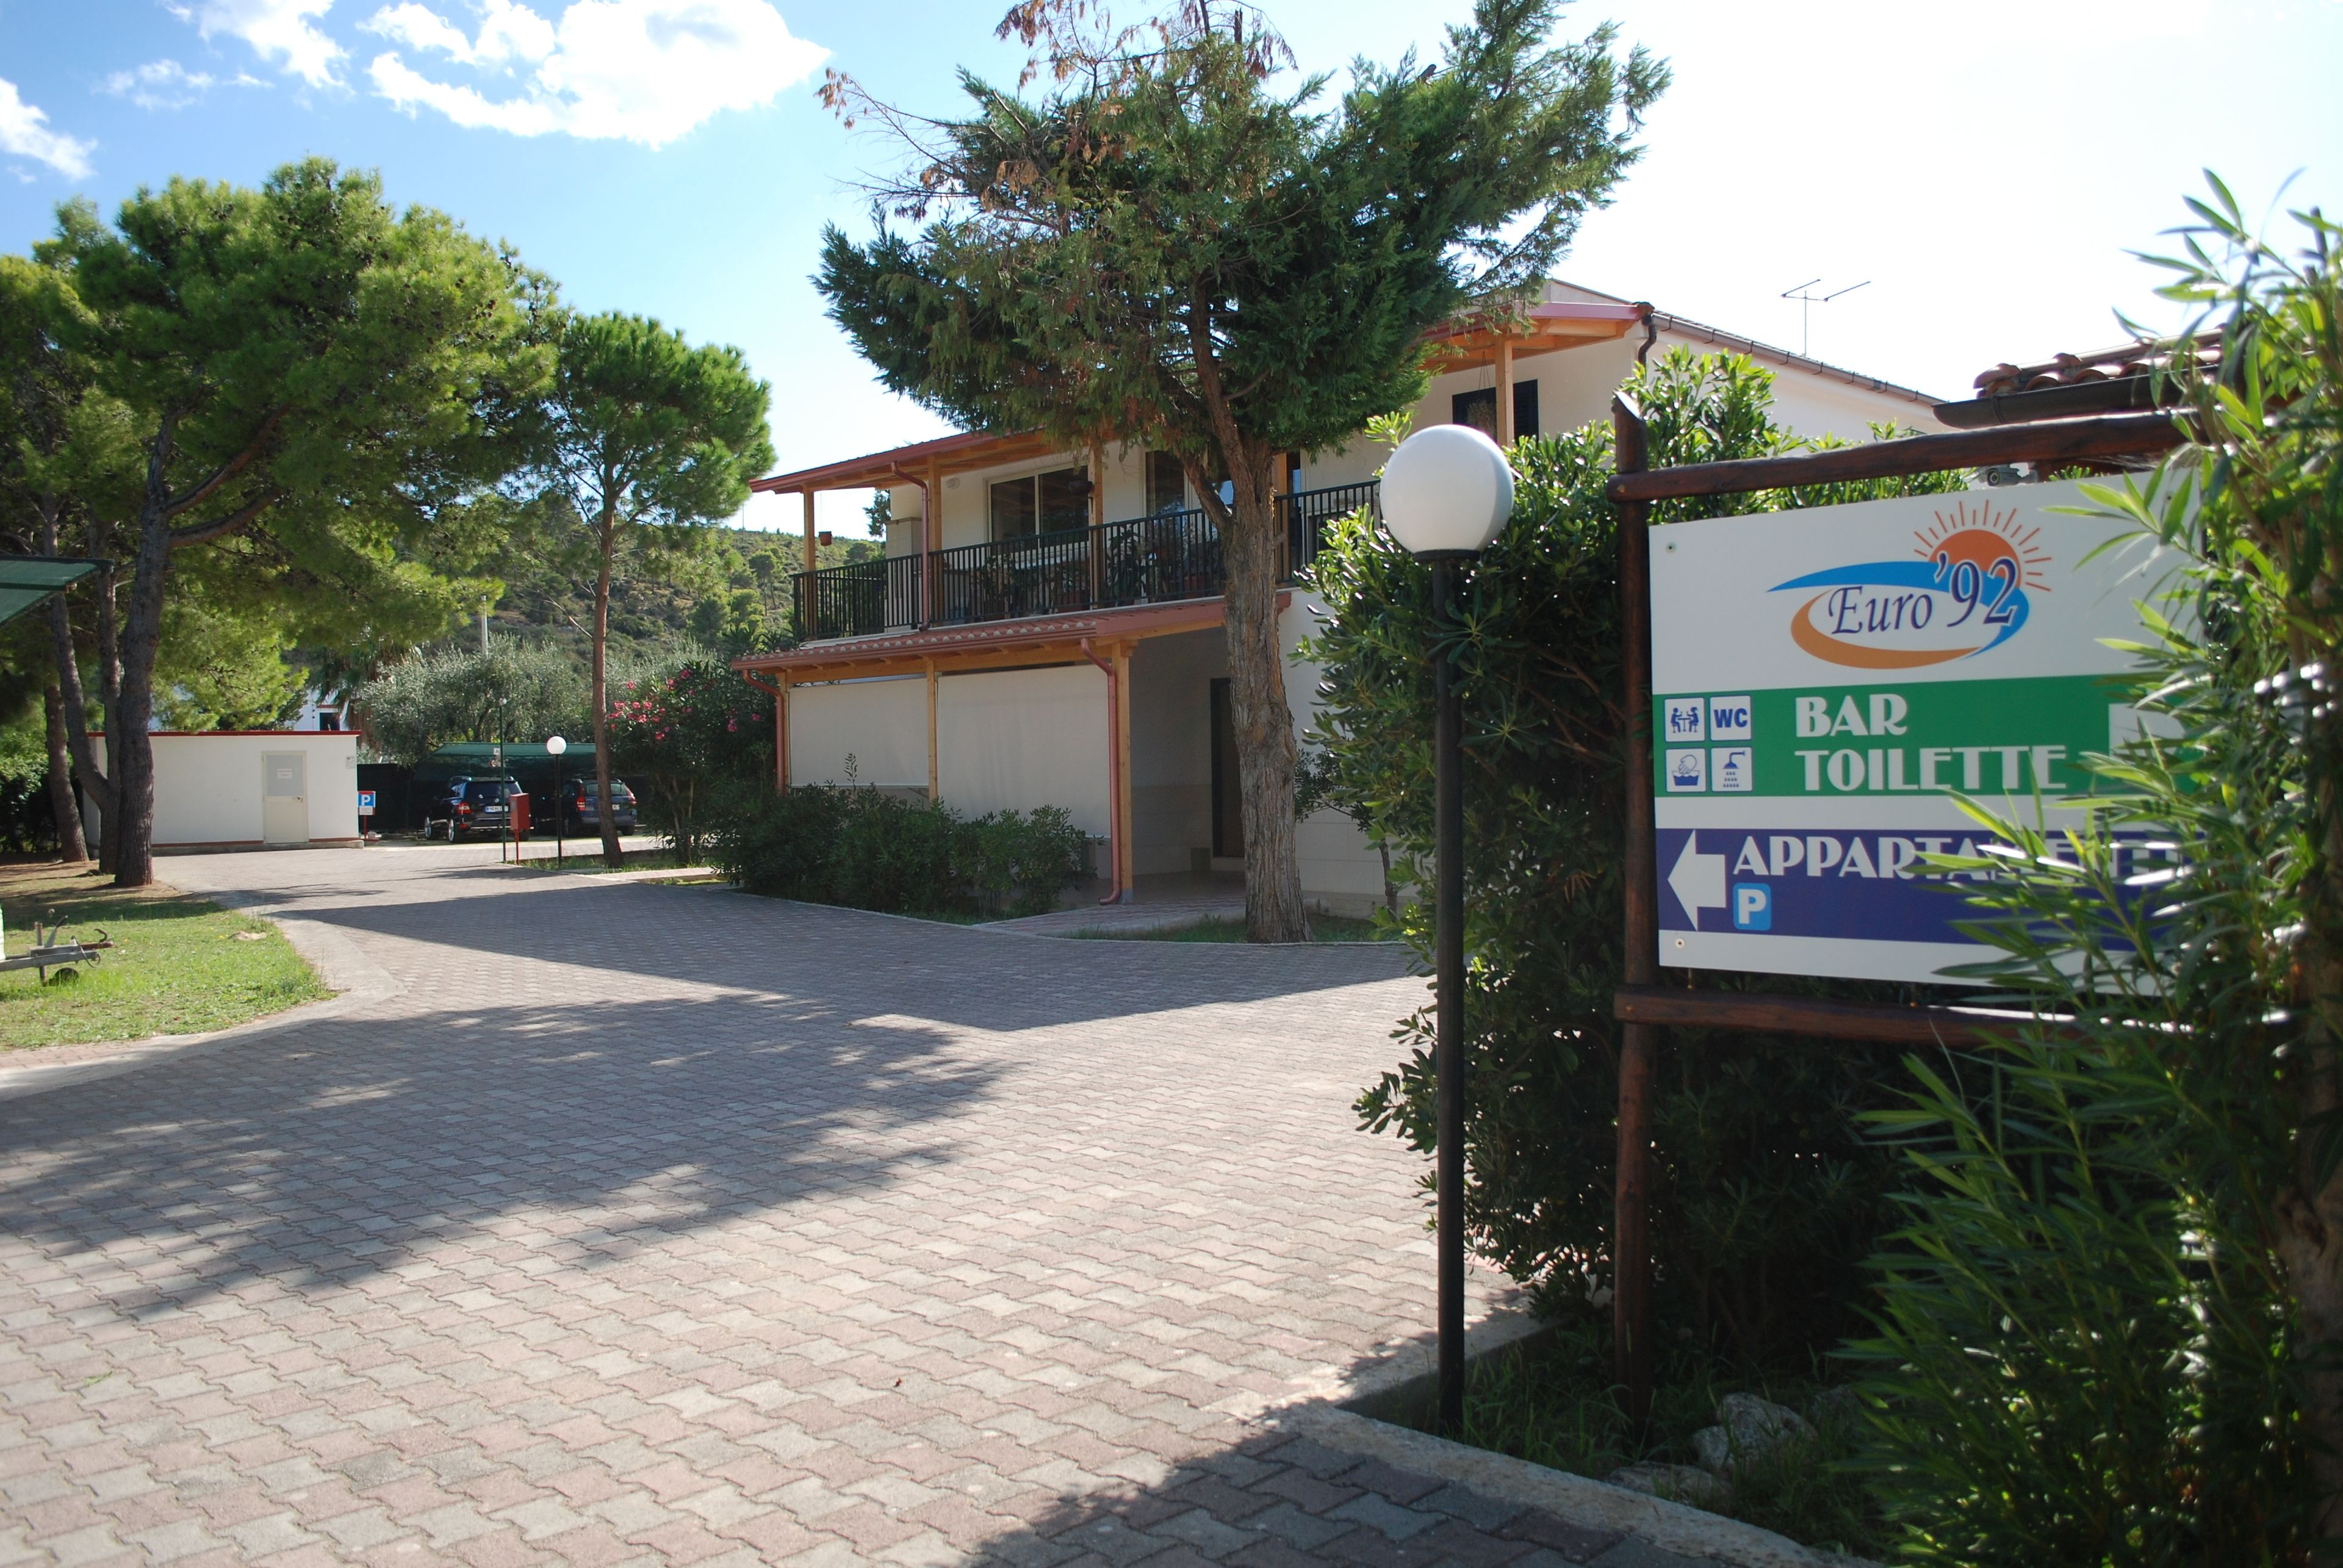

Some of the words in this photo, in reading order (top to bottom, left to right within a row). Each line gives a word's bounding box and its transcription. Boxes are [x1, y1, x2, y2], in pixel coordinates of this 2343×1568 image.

[1828, 586, 1933, 635] Euro
[1934, 550, 2018, 628] '92
[1713, 708, 1748, 728] WC
[1795, 693, 1908, 738] BAR
[1794, 745, 2067, 792] TOILETTE
[361, 794, 371, 806] P
[1738, 888, 1766, 924] P
